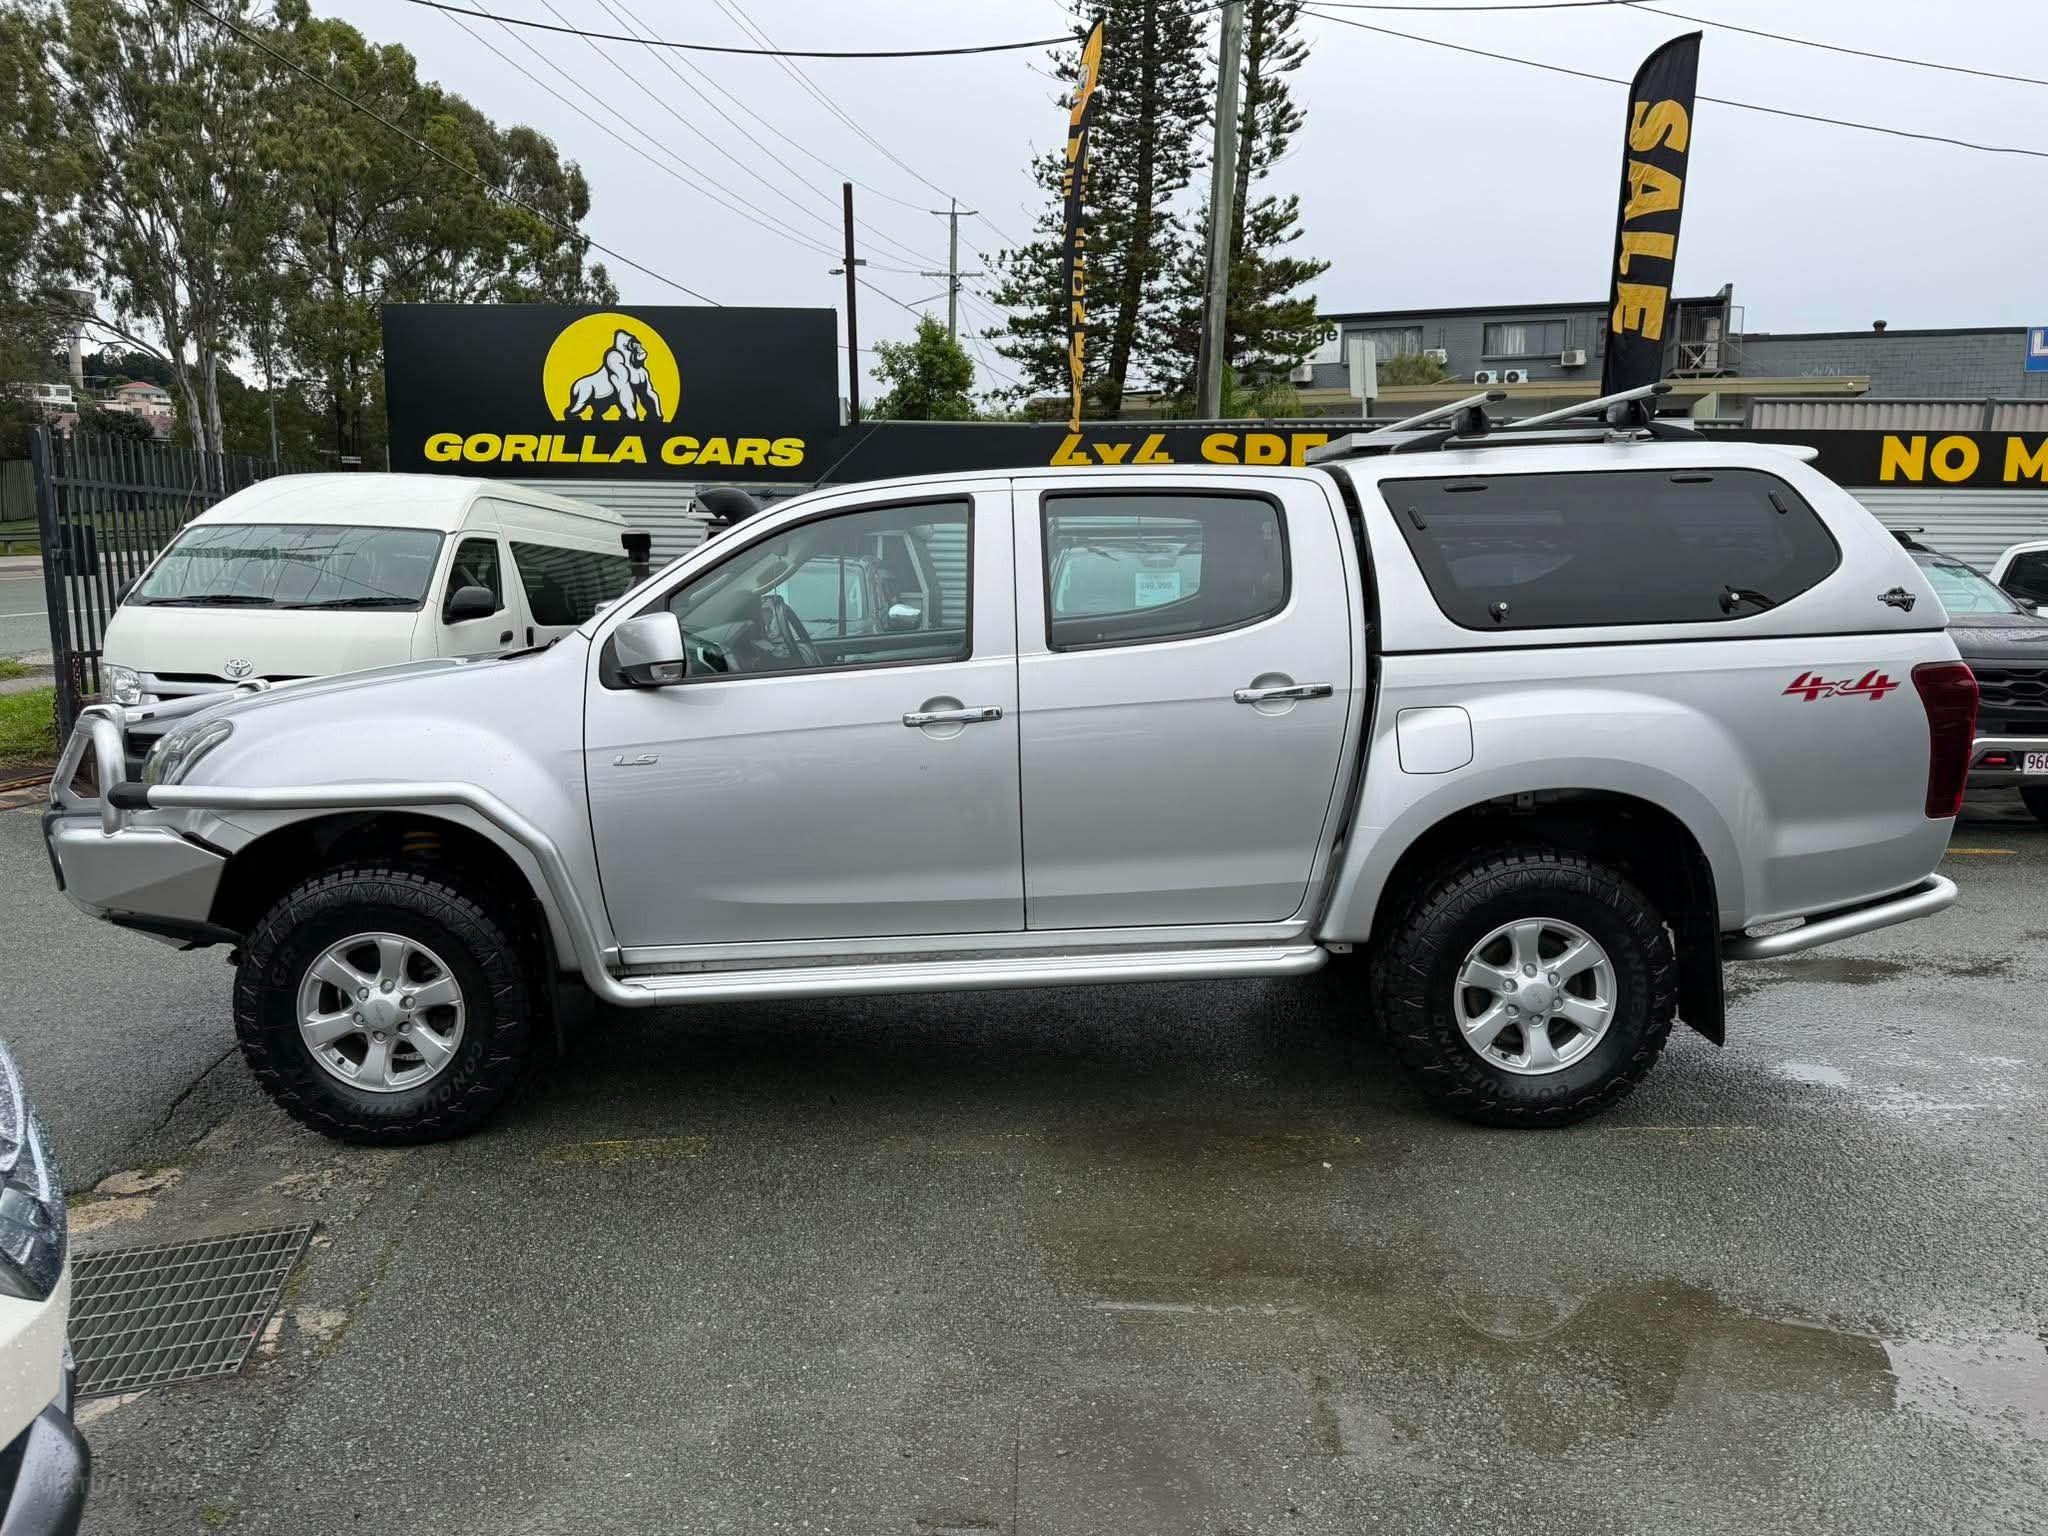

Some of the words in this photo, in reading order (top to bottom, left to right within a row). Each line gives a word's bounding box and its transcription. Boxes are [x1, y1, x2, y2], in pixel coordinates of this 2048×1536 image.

[1612, 100, 1690, 341] SALE
[424, 432, 648, 463] GORILLA
[661, 436, 805, 467] CARS
[1050, 433, 1175, 466] 4x4
[1879, 435, 1980, 482] NO
[1781, 669, 1902, 702] 4x4
